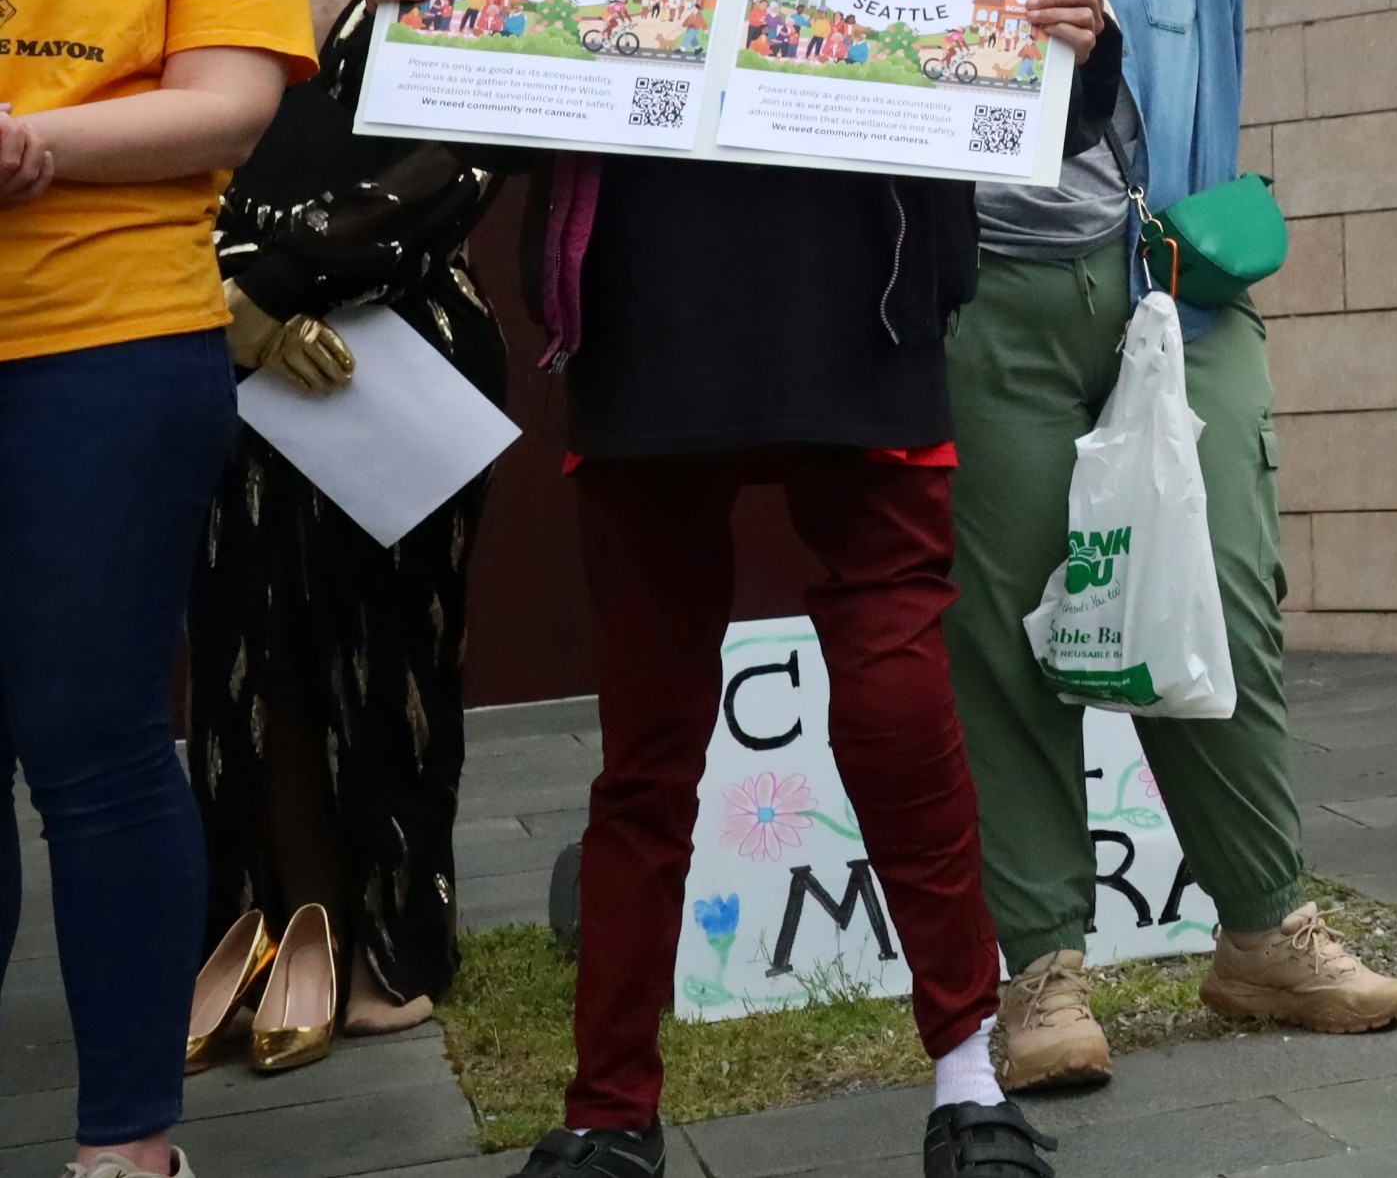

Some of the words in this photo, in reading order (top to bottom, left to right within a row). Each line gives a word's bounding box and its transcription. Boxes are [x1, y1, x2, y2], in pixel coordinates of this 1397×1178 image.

[15, 39, 105, 63] MAYOR
[408, 58, 440, 67] Power
[452, 62, 474, 73] only
[488, 66, 514, 75] good
[409, 71, 431, 79] Join
[476, 78, 507, 86] gather
[523, 81, 558, 91] remind
[560, 85, 577, 93] the
[579, 86, 611, 97] Wilson
[758, 84, 788, 94] Power
[800, 89, 820, 99] only
[834, 93, 858, 102] good
[398, 83, 471, 96] administration
[472, 89, 494, 98] that
[495, 92, 554, 103] surveillance
[566, 99, 583, 107] not
[421, 96, 437, 106] We
[439, 100, 465, 109] need
[466, 102, 523, 114] community
[525, 106, 542, 115] not
[823, 105, 853, 113] gather
[868, 108, 901, 118] remind
[903, 111, 919, 120] the
[920, 113, 952, 123] Wilson
[748, 108, 818, 122] administration
[820, 115, 839, 124] that
[841, 118, 898, 129] surveillance
[772, 122, 787, 131] We
[788, 126, 813, 134] need
[814, 128, 869, 140] community
[1068, 526, 1132, 558] ANK
[1060, 650, 1111, 659] REUSABLE
